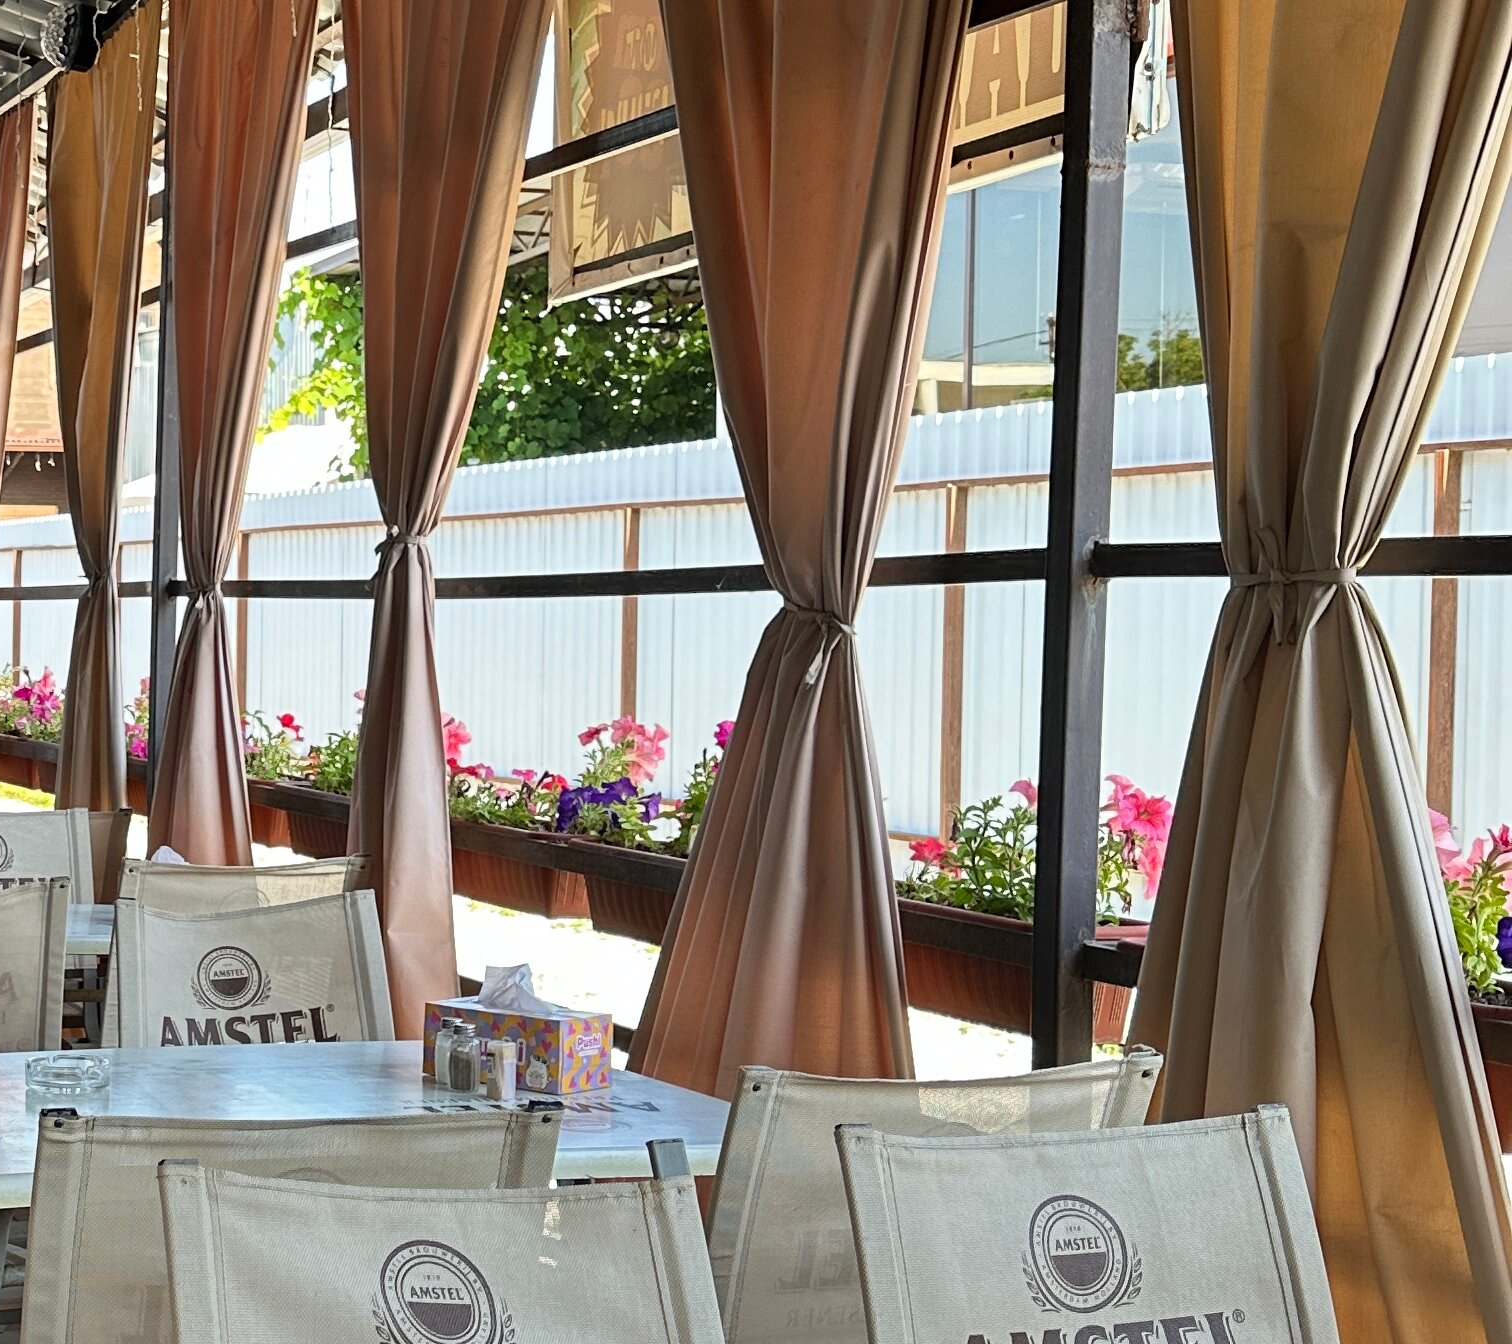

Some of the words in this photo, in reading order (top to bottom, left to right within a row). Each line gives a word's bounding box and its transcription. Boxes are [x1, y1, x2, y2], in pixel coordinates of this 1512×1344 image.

[161, 1006, 340, 1047] AMSTEL
[1055, 1236, 1101, 1252] AMSTEL
[410, 1286, 465, 1301] AMSTEL
